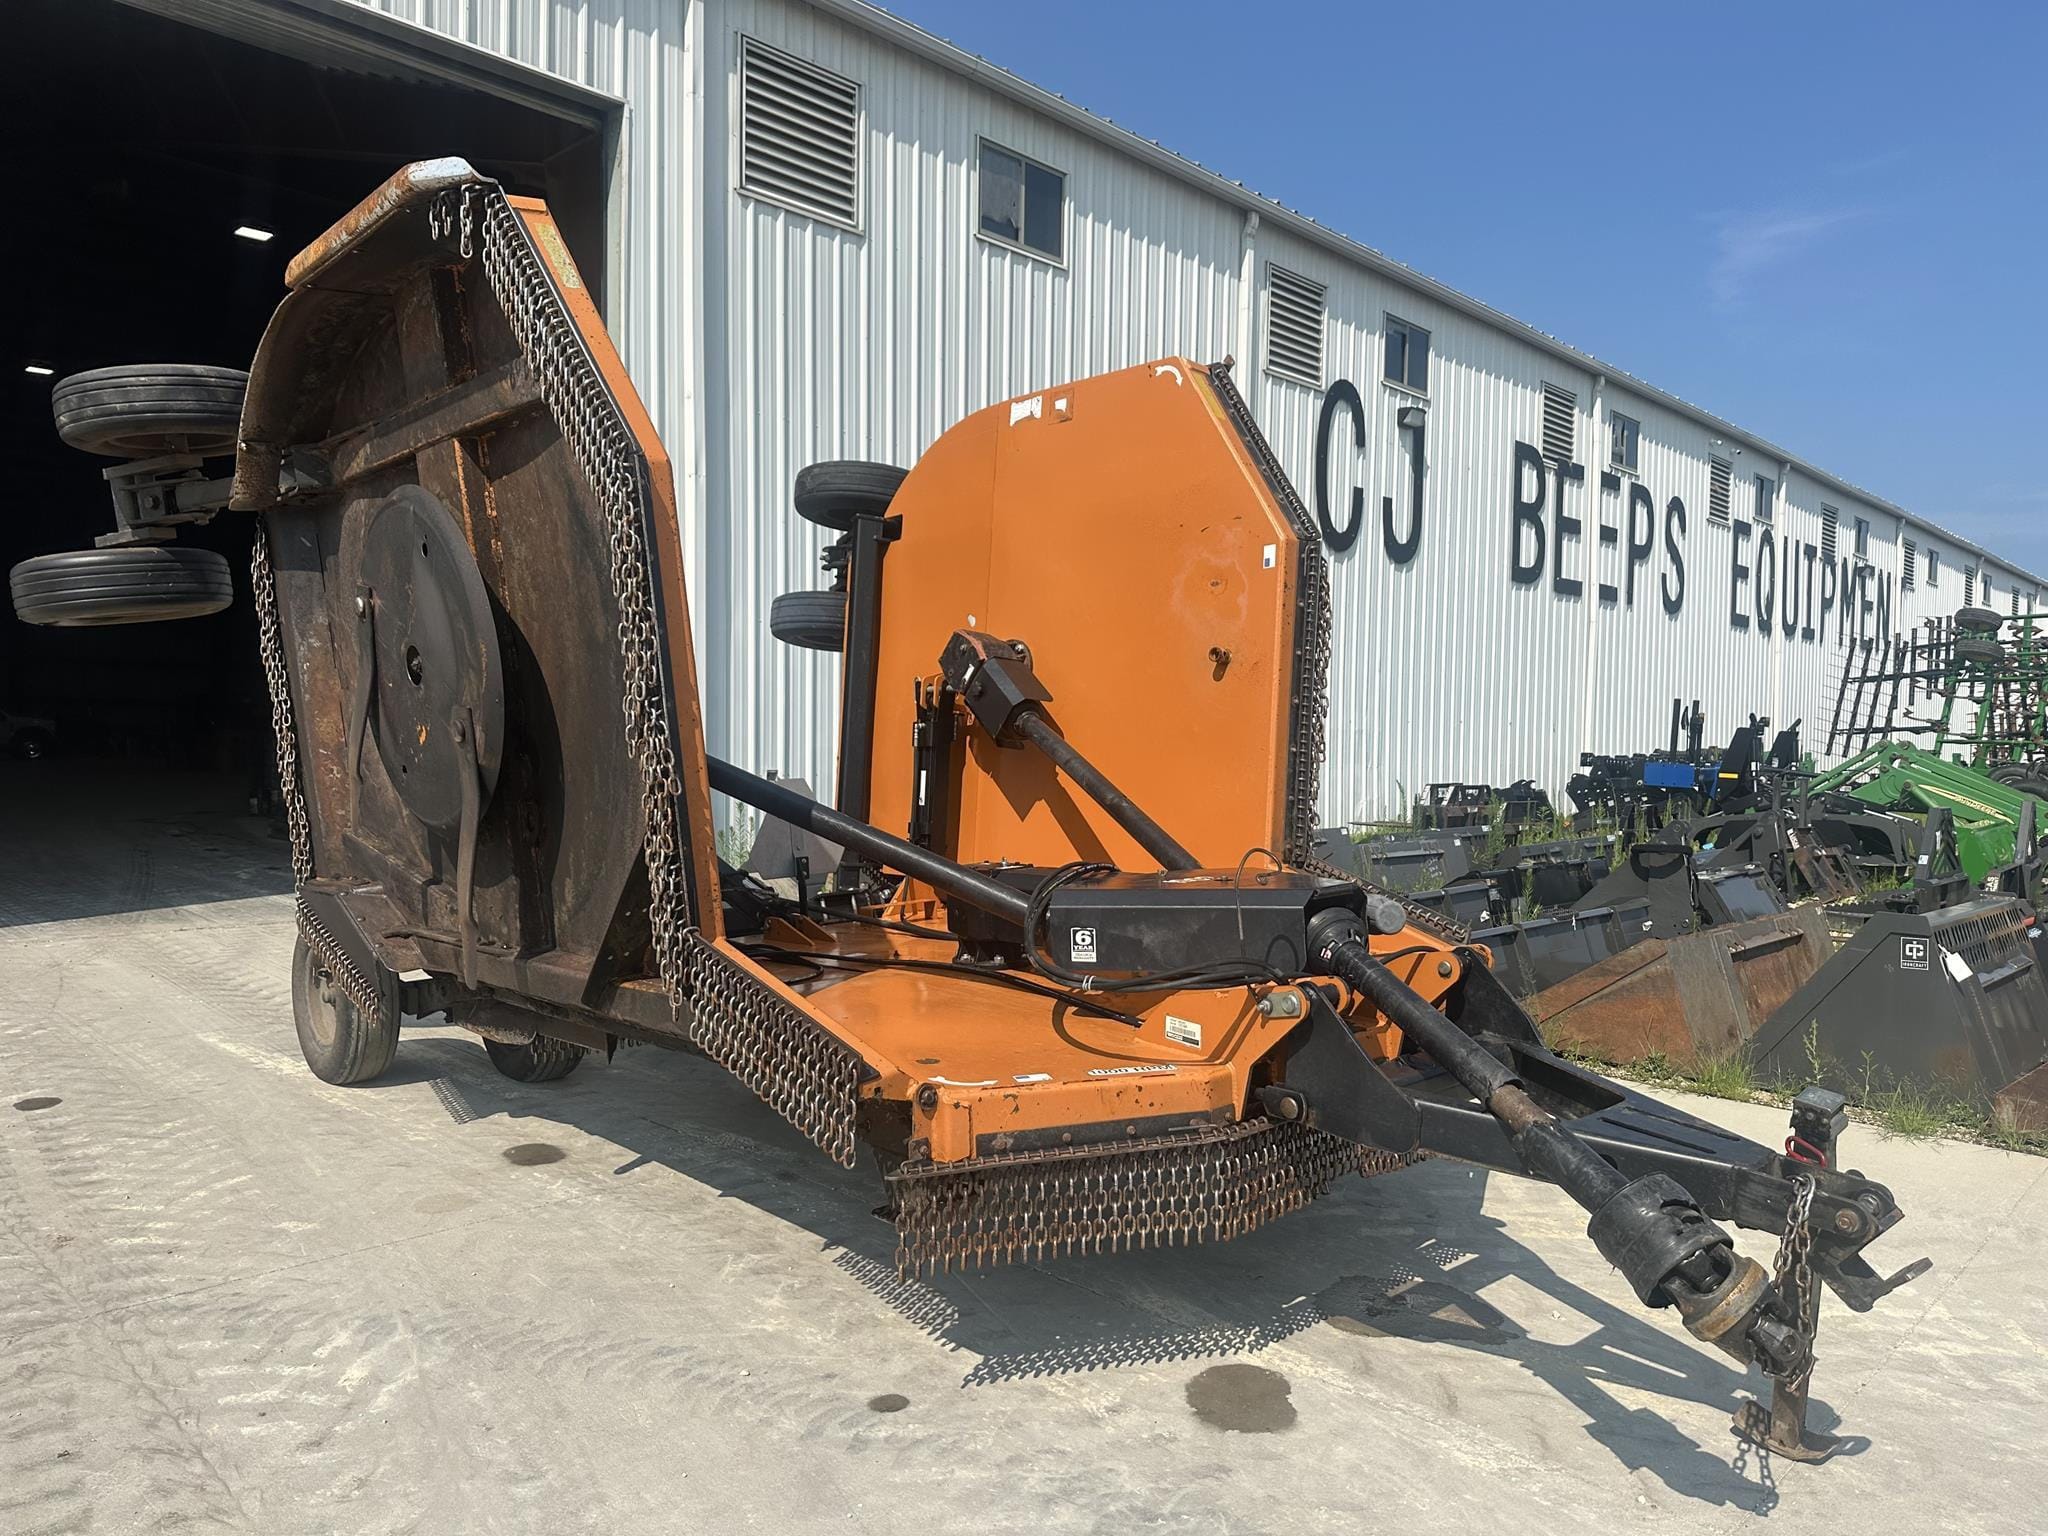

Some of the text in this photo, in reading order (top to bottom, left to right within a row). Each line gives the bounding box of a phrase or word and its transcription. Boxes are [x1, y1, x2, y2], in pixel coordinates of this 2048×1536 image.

[1316, 379, 1907, 654] CJ BEEPS EQUIPMEN
[1075, 930, 1091, 946] 6
